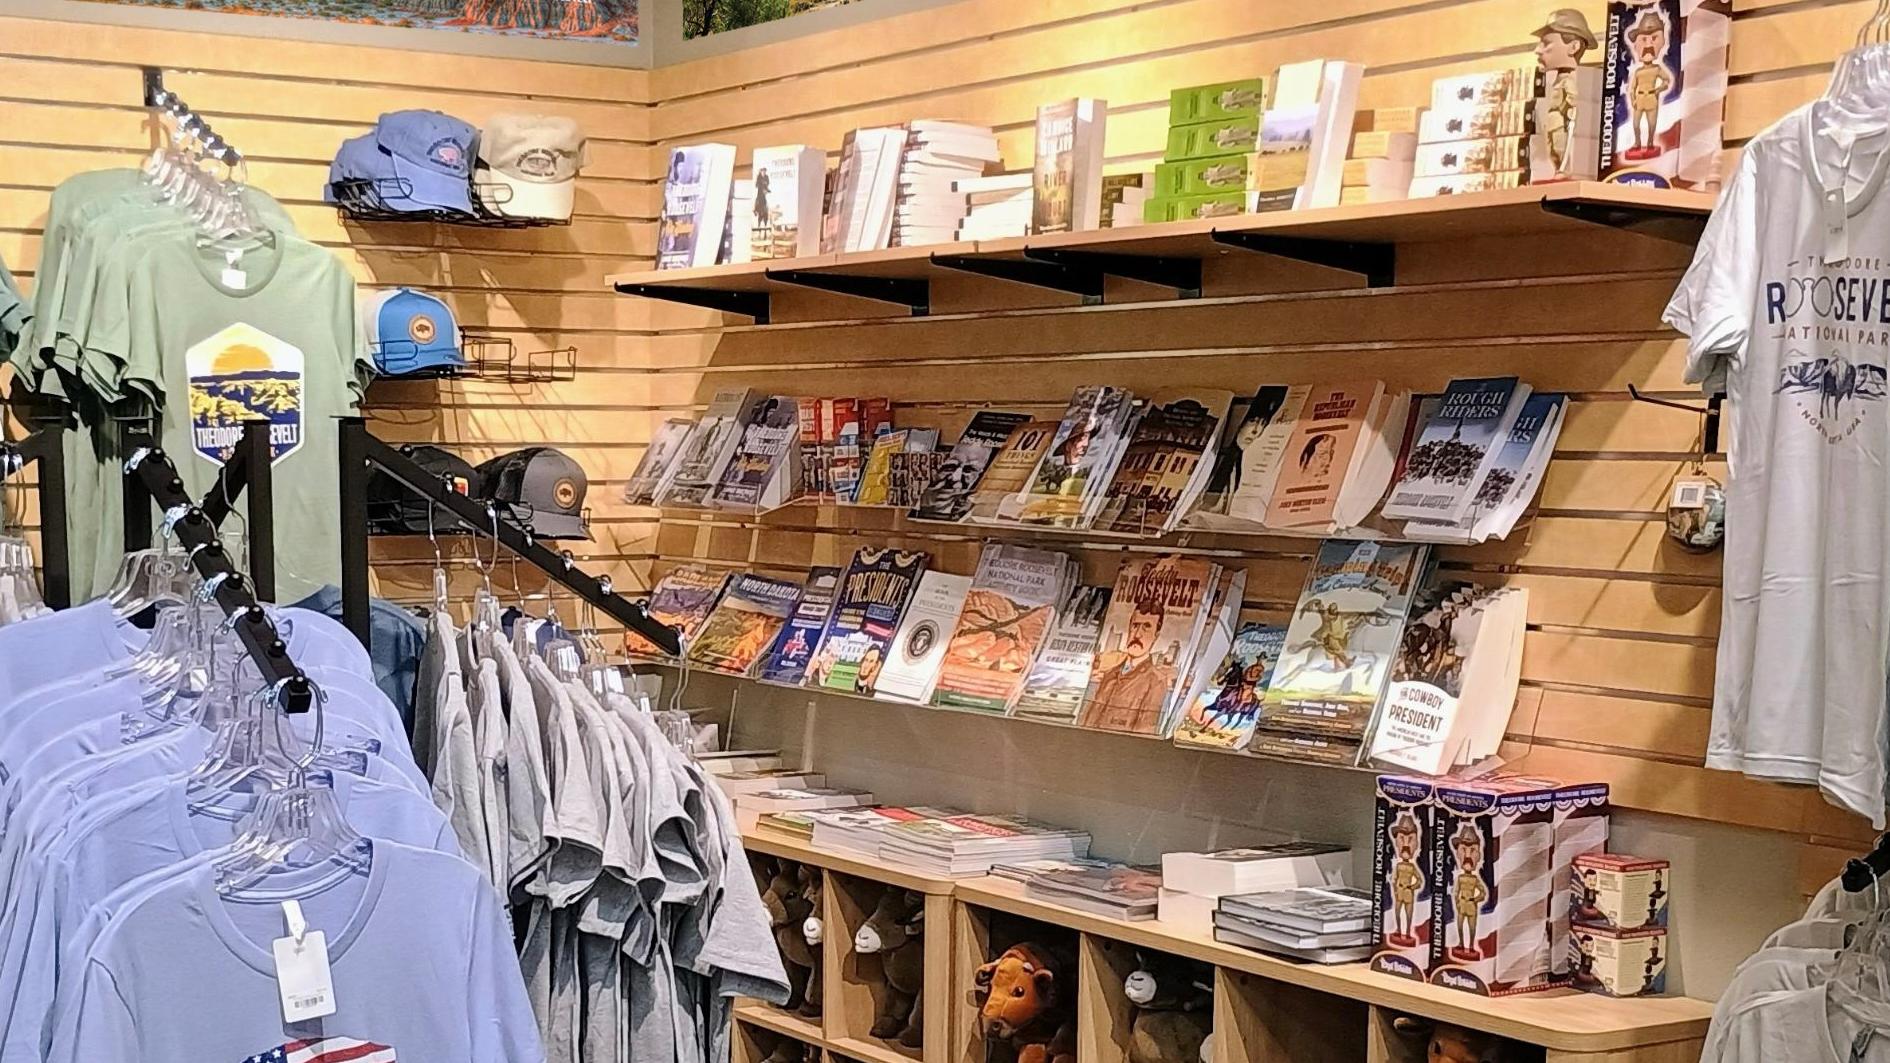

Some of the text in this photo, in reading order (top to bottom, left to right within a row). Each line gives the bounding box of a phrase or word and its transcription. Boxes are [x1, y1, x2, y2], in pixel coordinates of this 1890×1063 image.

[1600, 14, 1620, 169] THEODORE ROOSEVELT
[1808, 255, 1880, 271] THDORE
[1785, 326, 1849, 344] ATIONAL
[1447, 391, 1505, 406] ROUGH
[1438, 405, 1500, 418] RIDERS
[269, 423, 297, 445] SEVELT
[1013, 431, 1049, 451] 101
[739, 578, 768, 595] NORTH
[767, 584, 801, 601] DAKOTA
[846, 572, 911, 609] PRESIDENTS
[1115, 573, 1201, 608] ROOSEVELT
[1409, 689, 1445, 710] COWBOY
[1388, 704, 1444, 732] PRESIDENT
[1372, 807, 1386, 944] THEODORE ROOSEVELT
[1433, 817, 1447, 960] THEODORE ROOSEVELT
